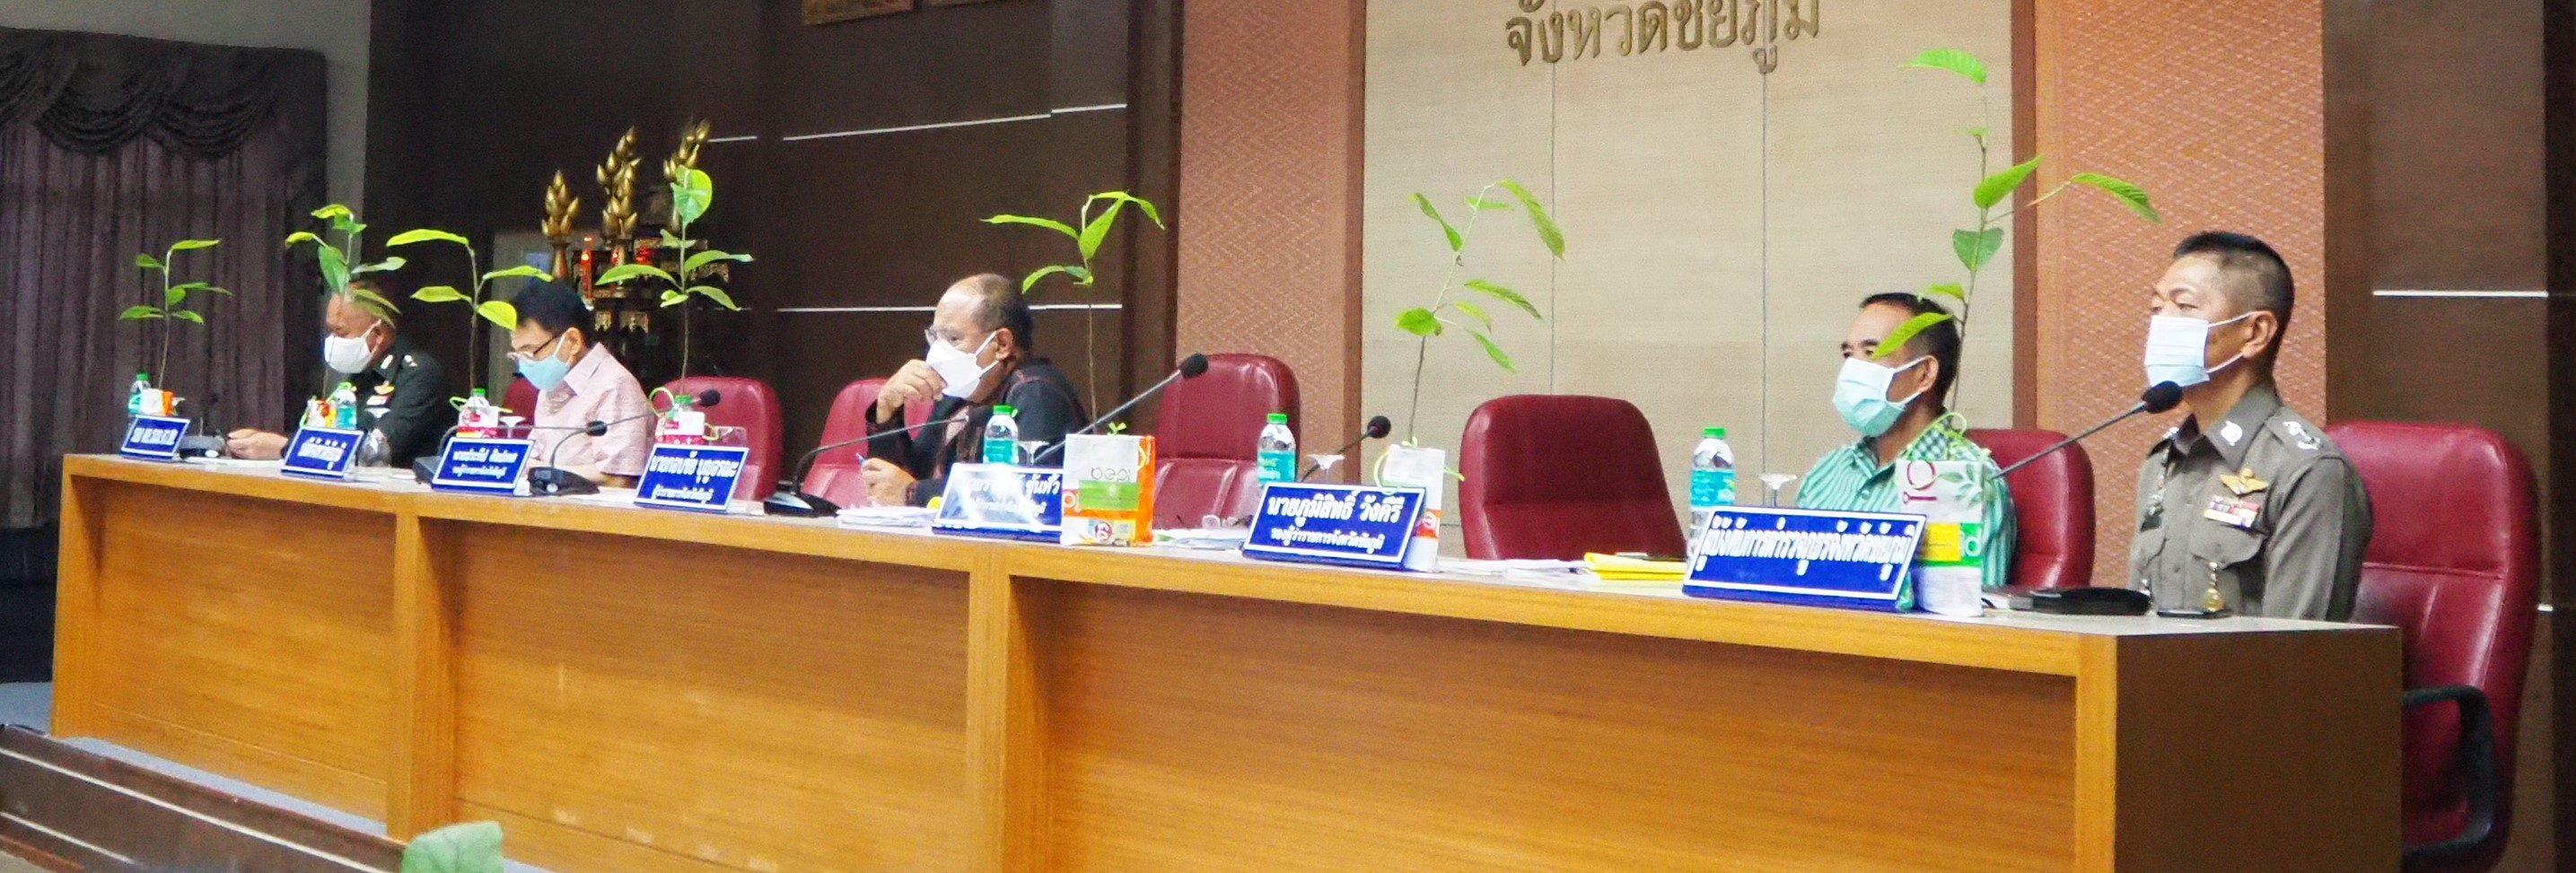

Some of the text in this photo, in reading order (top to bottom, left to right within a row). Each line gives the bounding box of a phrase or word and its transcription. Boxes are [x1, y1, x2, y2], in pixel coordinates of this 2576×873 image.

[1505, 0, 1820, 74] จังหวดชยภูม
